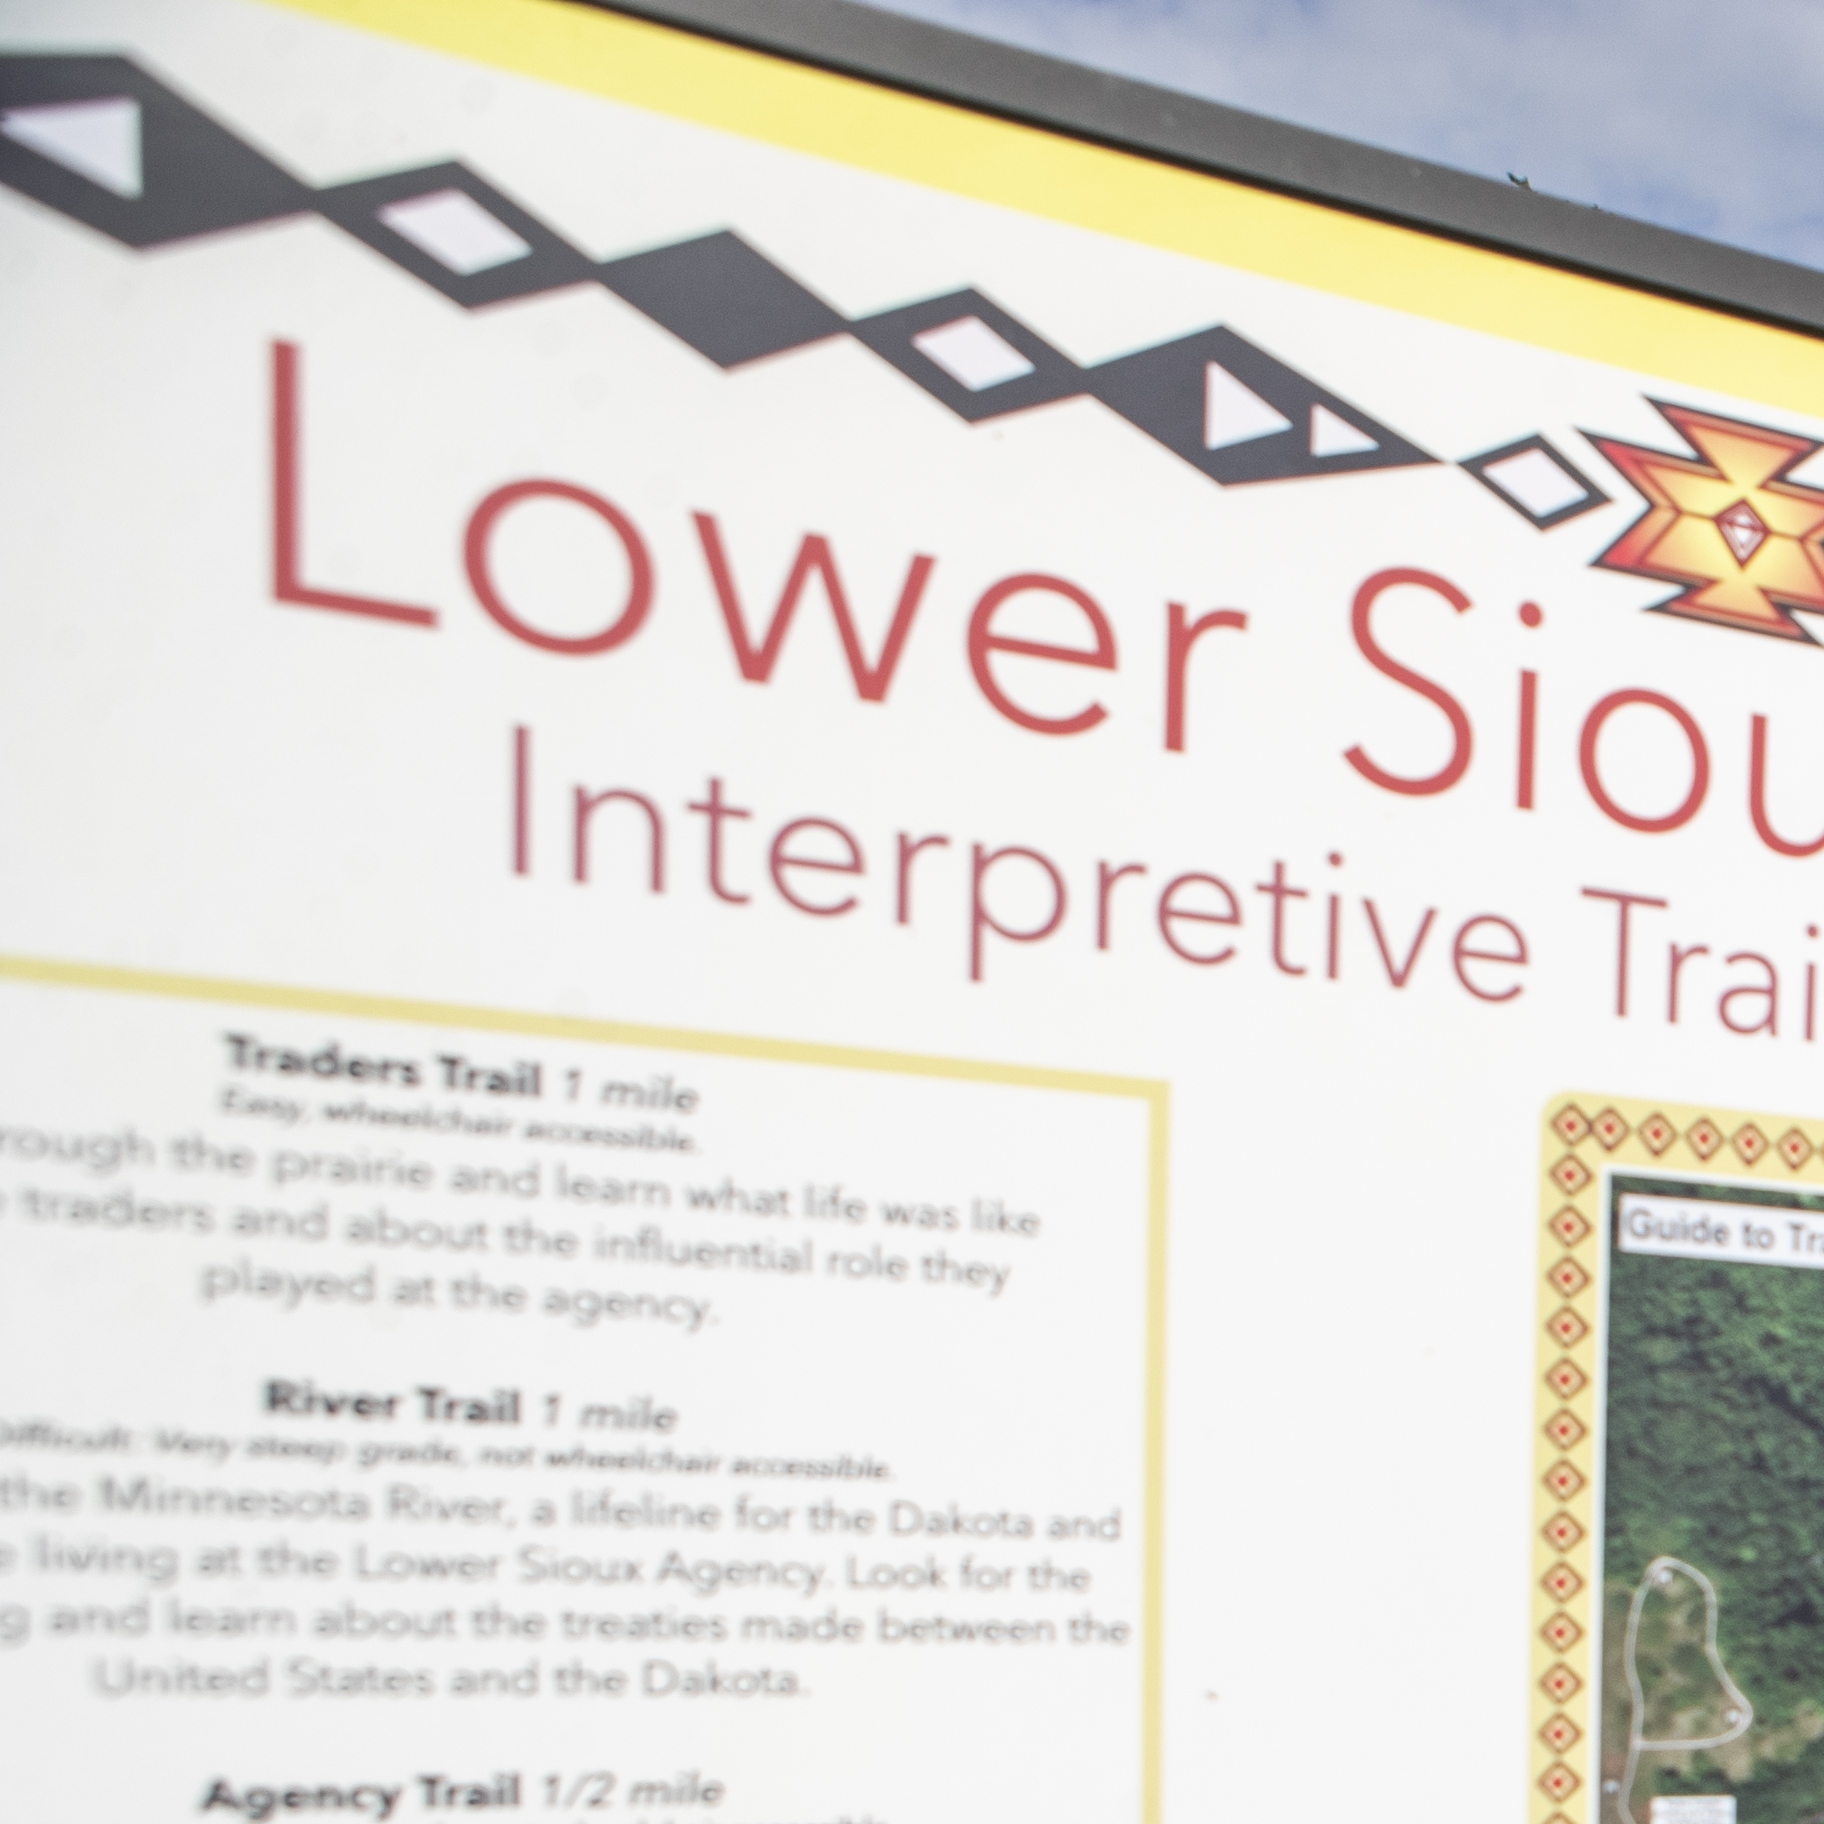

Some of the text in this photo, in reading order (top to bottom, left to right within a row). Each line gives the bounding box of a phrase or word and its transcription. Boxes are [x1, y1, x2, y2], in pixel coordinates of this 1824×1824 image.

[272, 339, 1250, 757] Lower
[513, 726, 1530, 1005] Interpretive
[225, 1032, 698, 1116] Traders Trail 1 mile
[318, 1100, 514, 1137] wheelchair
[167, 1133, 1041, 1238] the prairie and learn what life was like
[22, 1187, 1010, 1298] traders and about the influential role they
[1626, 1207, 1730, 1246] Guide
[1742, 1218, 1776, 1250] to
[196, 1258, 379, 1311] played
[389, 1276, 437, 1308] at
[448, 1272, 529, 1314] the
[260, 1378, 677, 1435] River Trail 1 mile
[0, 1475, 82, 1514] the
[94, 1474, 372, 1523] Minnesota
[569, 1488, 722, 1532] lifeline
[733, 1492, 793, 1534] for
[806, 1498, 877, 1536] the
[887, 1499, 1036, 1541] Dakota
[1046, 1508, 1124, 1543] and
[29, 1533, 181, 1589] living
[194, 1545, 244, 1578] at
[254, 1540, 340, 1580] the
[351, 1543, 501, 1583] Lower
[516, 1543, 644, 1587] Sioux
[844, 1554, 947, 1591] Look
[958, 1553, 1014, 1592] for
[1025, 1558, 1092, 1594] the
[45, 1597, 152, 1638] and
[163, 1599, 298, 1638] learn
[311, 1600, 459, 1640] about
[468, 1602, 548, 1641] the
[559, 1610, 728, 1643] treaties
[739, 1607, 865, 1644] made
[875, 1609, 1057, 1645] between
[1069, 1609, 1131, 1648] the
[89, 1657, 273, 1699] United
[284, 1657, 436, 1698] States
[448, 1659, 542, 1698] and
[551, 1659, 629, 1697] the
[198, 1770, 724, 1824] Agency Trail 1/2 mile
